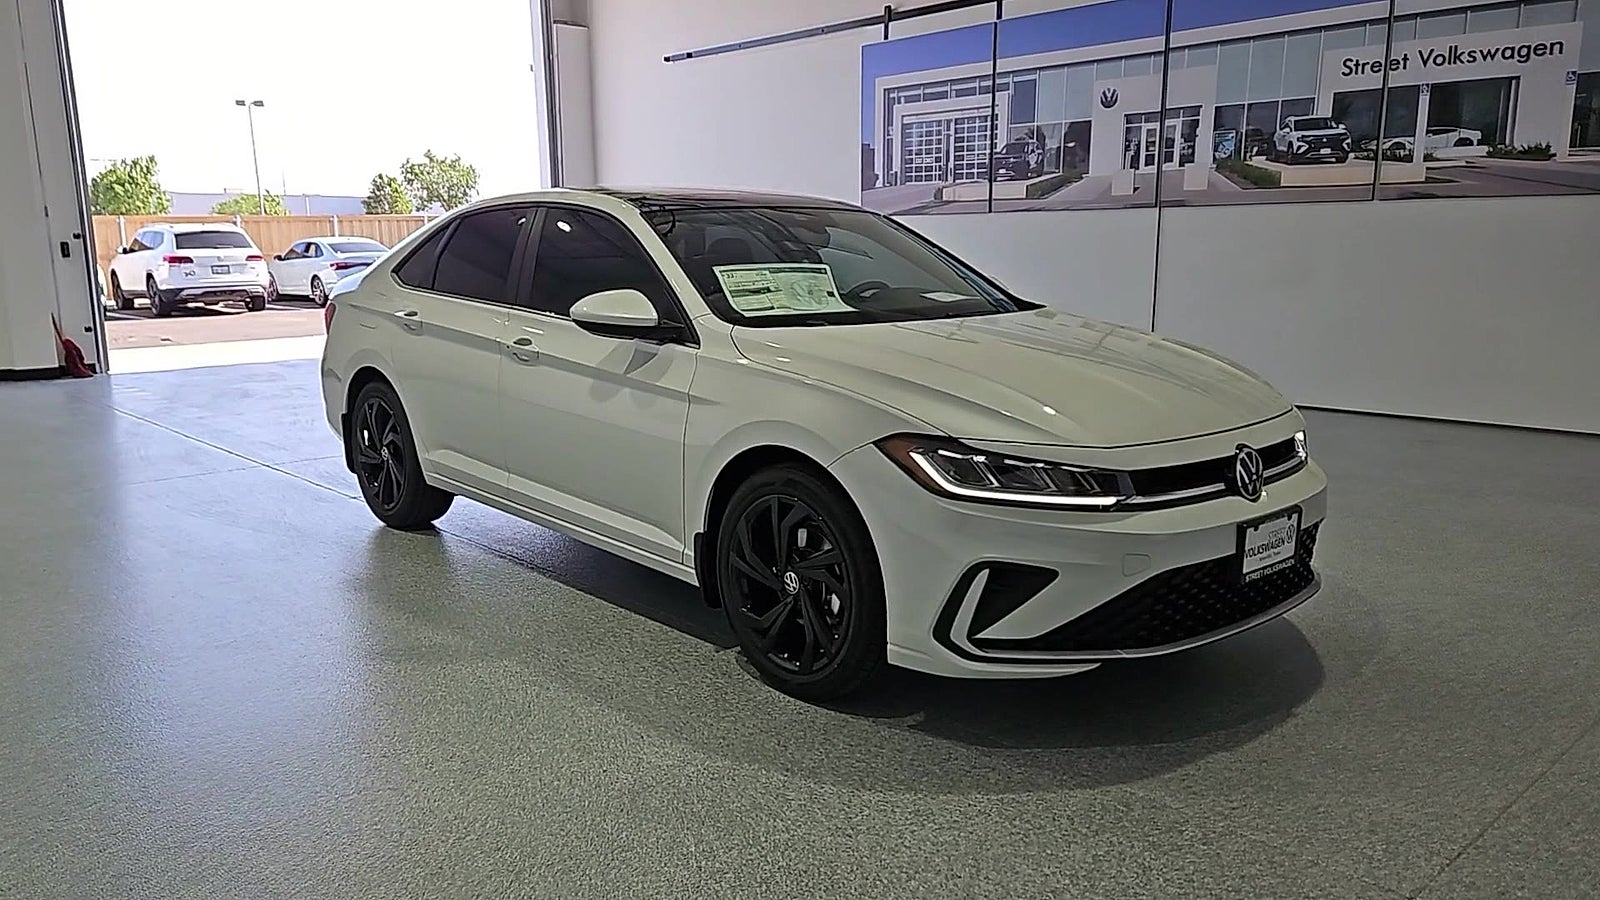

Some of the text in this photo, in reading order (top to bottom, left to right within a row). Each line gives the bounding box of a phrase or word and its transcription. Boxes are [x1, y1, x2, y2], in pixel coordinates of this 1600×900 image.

[1341, 40, 1564, 77] Street Volkswagen
[1245, 537, 1285, 559] VOLKSWAGEN
[1245, 559, 1295, 582] STREET VOLKSWAGEN
